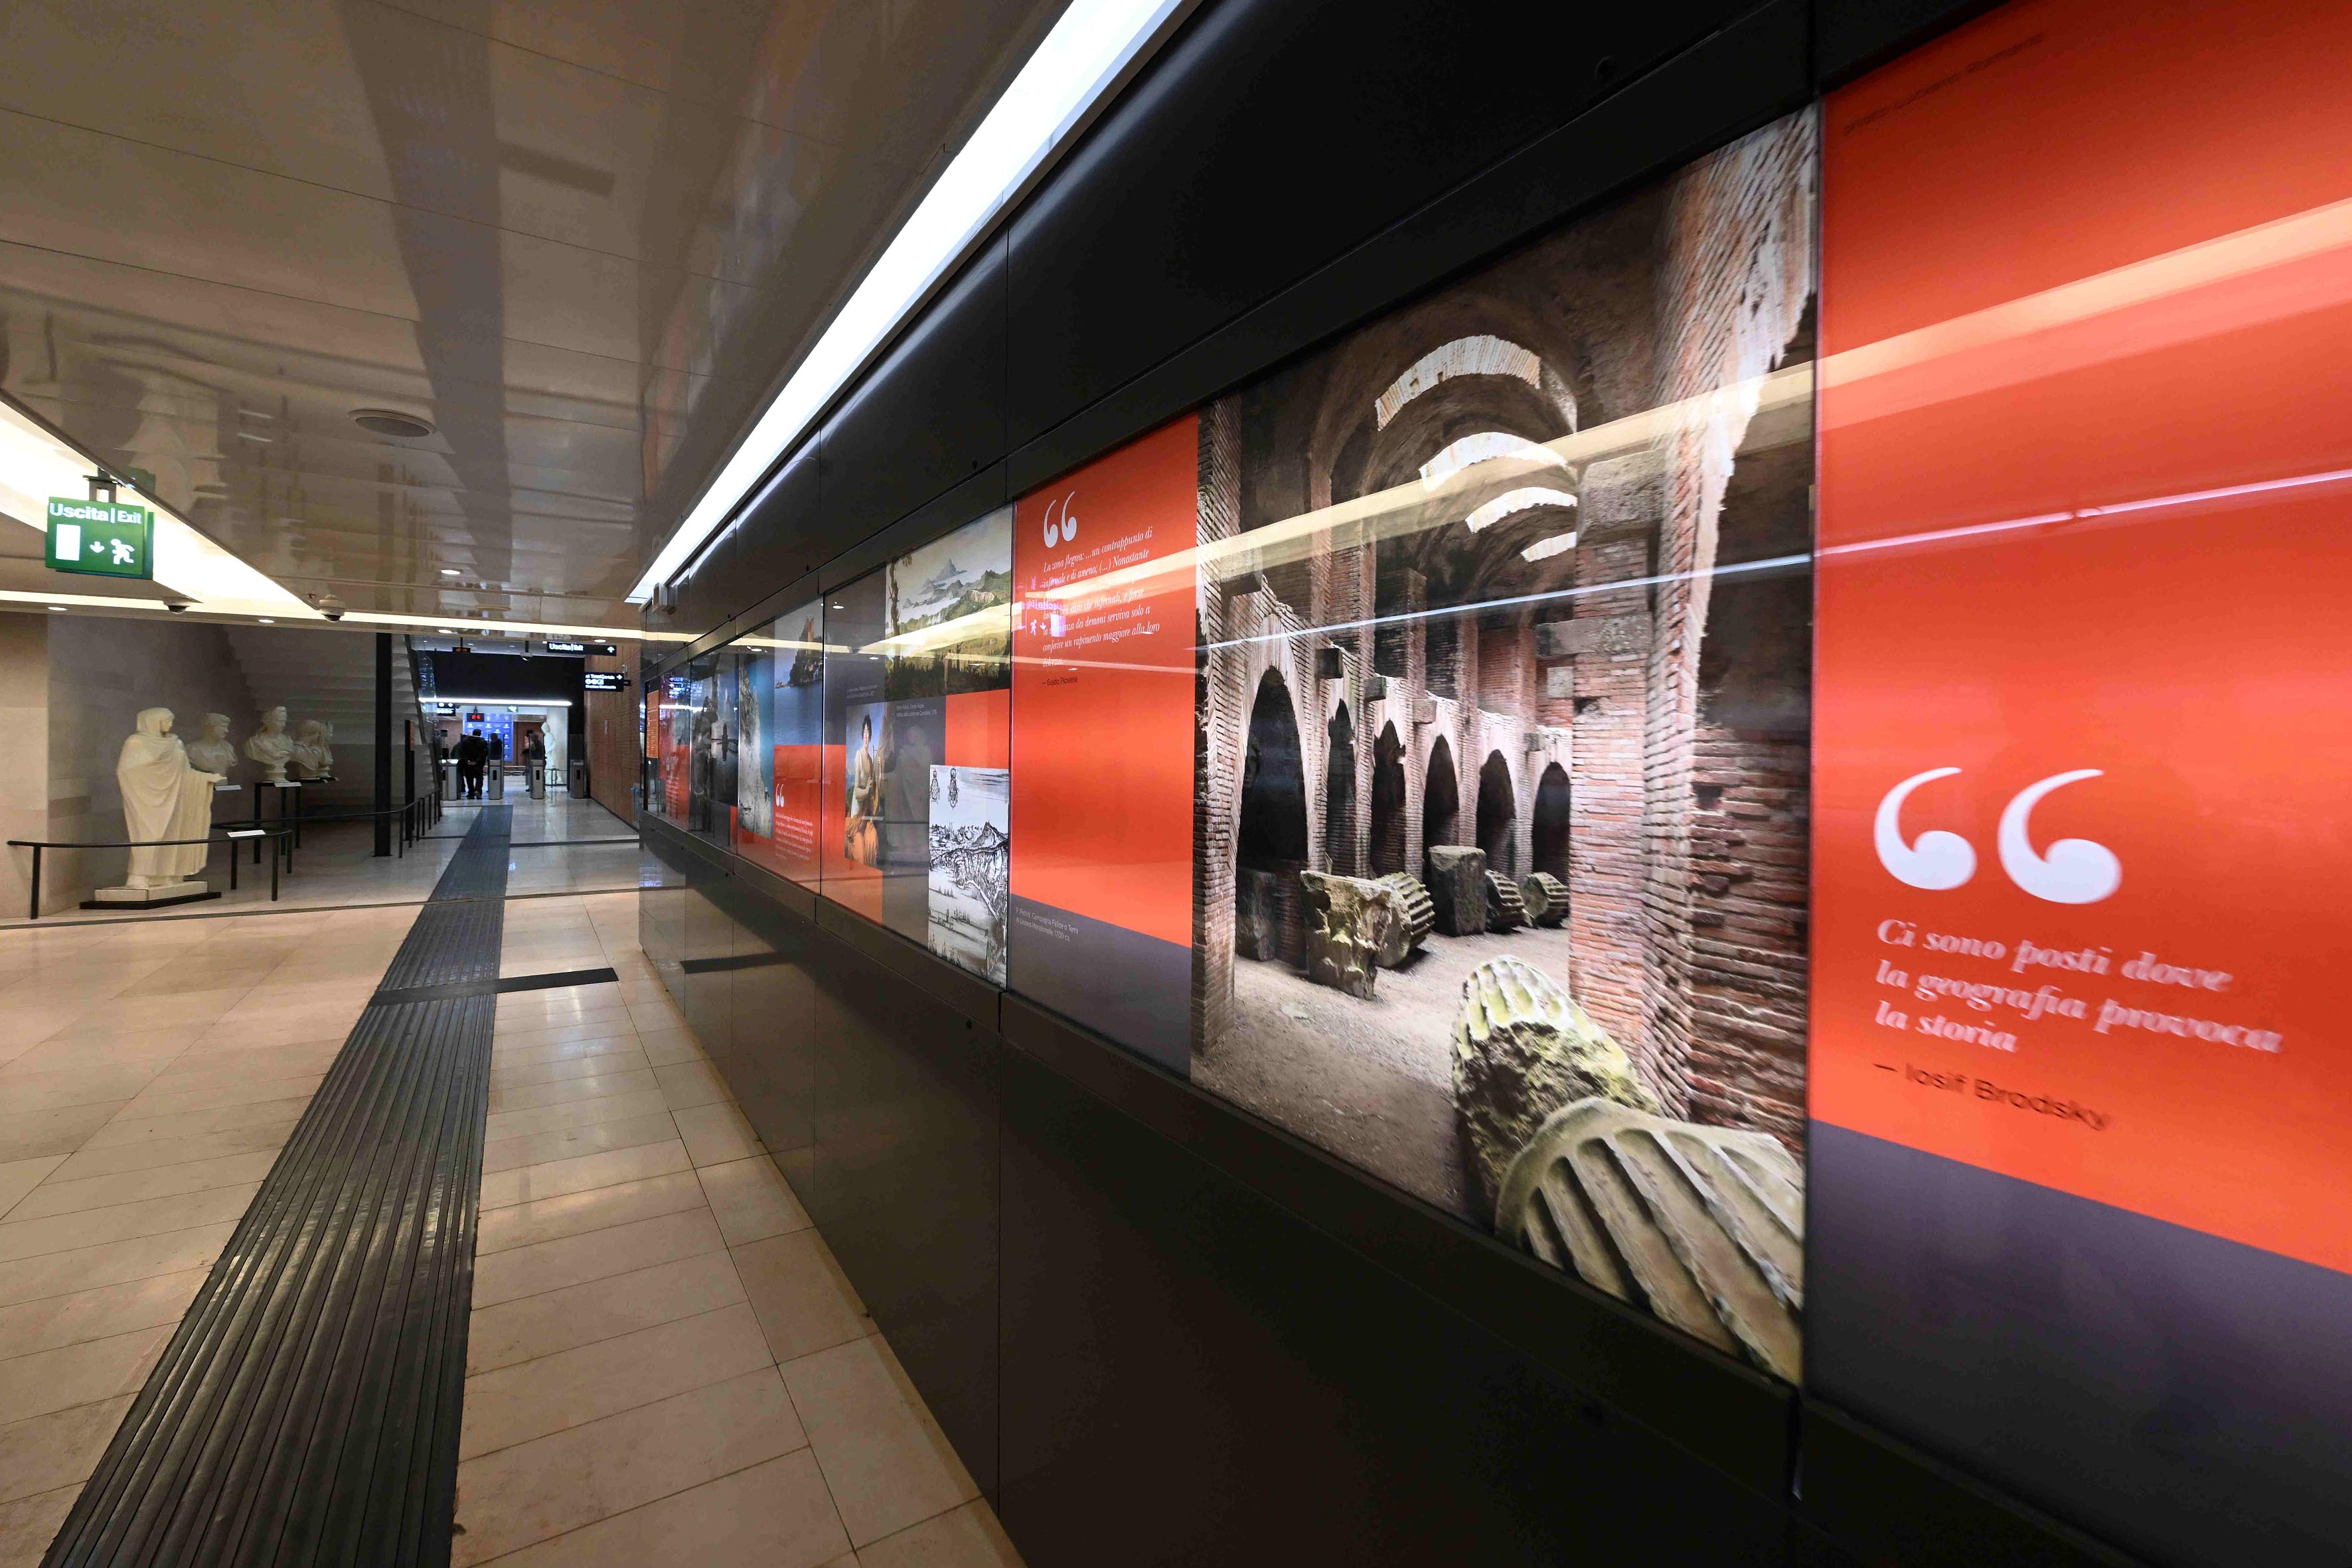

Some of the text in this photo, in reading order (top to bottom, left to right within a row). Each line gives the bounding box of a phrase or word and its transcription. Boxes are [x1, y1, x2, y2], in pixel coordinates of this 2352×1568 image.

[49, 503, 142, 524] Uscita Exit
[1044, 562, 1051, 572] La
[1052, 560, 1064, 570] zona
[1101, 532, 1144, 552] contrappunto
[1144, 526, 1153, 538] di
[1044, 573, 1065, 590] infernale
[1071, 569, 1077, 580] di
[1113, 549, 1149, 568] Nonostante
[1042, 621, 1160, 654] conferire un rapimento maggiore alla loro
[1075, 617, 1084, 629] dei
[1085, 613, 1106, 627] demoni
[1107, 608, 1130, 621] serviva
[1131, 605, 1144, 617] solo
[1145, 605, 1150, 615] a
[1877, 917, 2234, 993] Ci sono posti dove
[1875, 1000, 2019, 1054] la storia
[1876, 959, 2284, 1055] la geografia provoca
[1974, 1079, 2115, 1133] Brodsky
